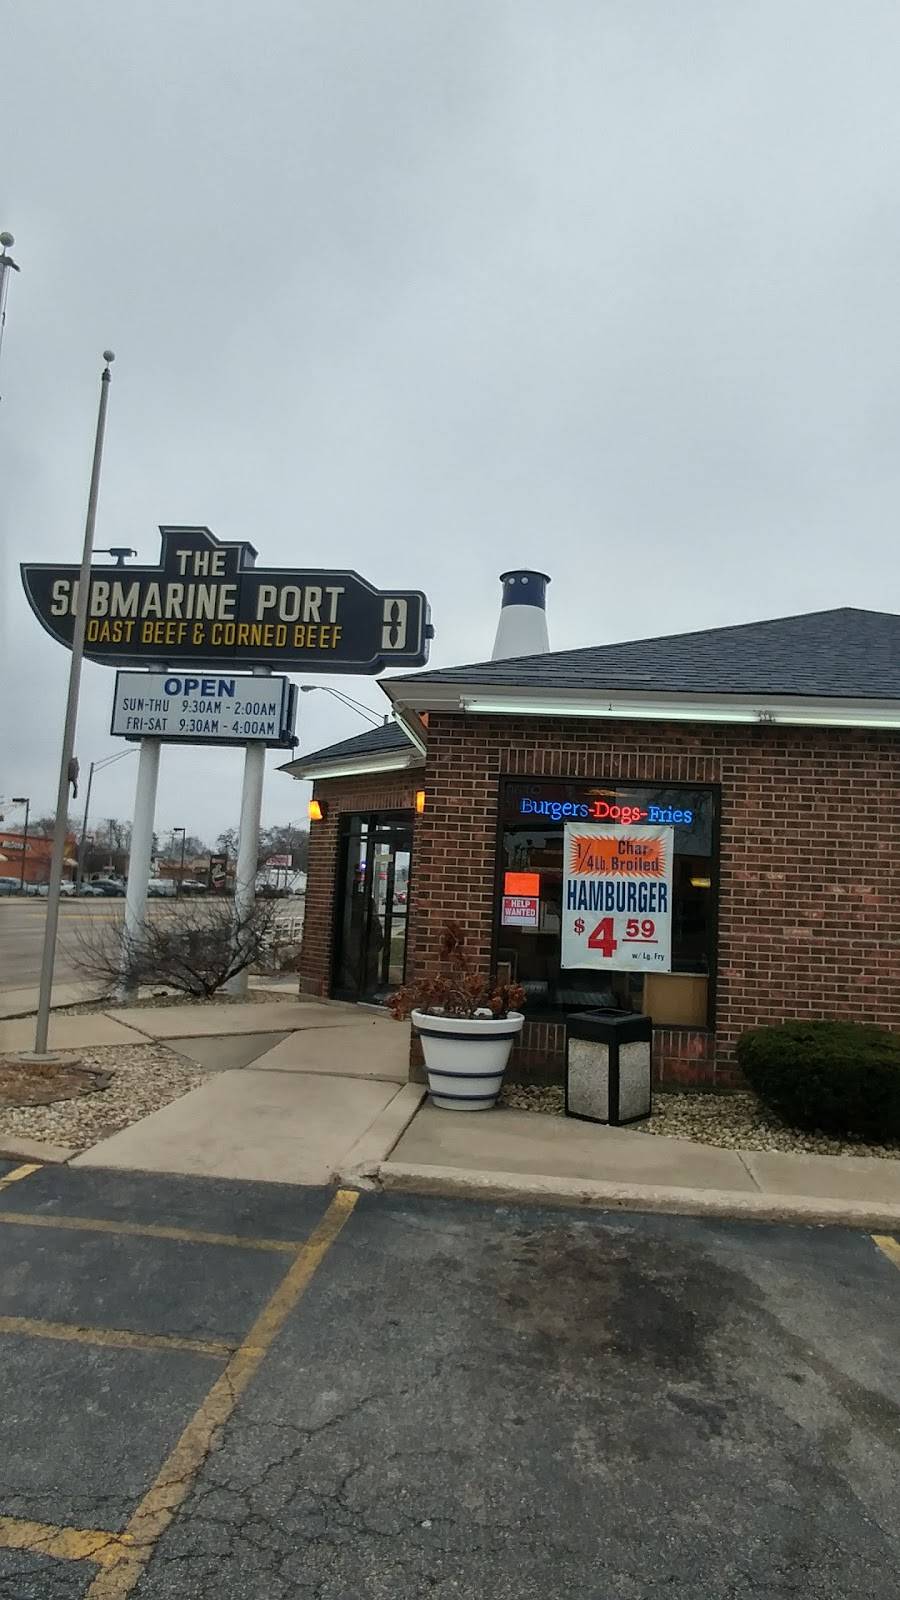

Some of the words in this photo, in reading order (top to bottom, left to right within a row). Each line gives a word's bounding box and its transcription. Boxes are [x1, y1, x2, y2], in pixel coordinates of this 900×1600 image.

[176, 550, 227, 577] THE
[256, 584, 345, 624] PORT
[86, 620, 136, 643] OAST
[142, 622, 188, 645] BEEF
[192, 623, 206, 646] &
[211, 623, 288, 648] CORNED
[293, 625, 343, 649] BEEF
[164, 677, 236, 698] OPEN
[122, 698, 170, 713] SUN-THU
[182, 699, 222, 715] 9:30AM
[234, 701, 277, 717] 2:00AM
[126, 716, 168, 732] FRI-SAT
[179, 718, 219, 734] 9:30AM
[231, 720, 276, 736] 4:00AM
[611, 856, 659, 871] Broiled
[510, 899, 531, 909] HELP
[567, 879, 668, 914] HAMBURGER
[504, 907, 536, 918] WANTED
[654, 952, 665, 961] Fry
